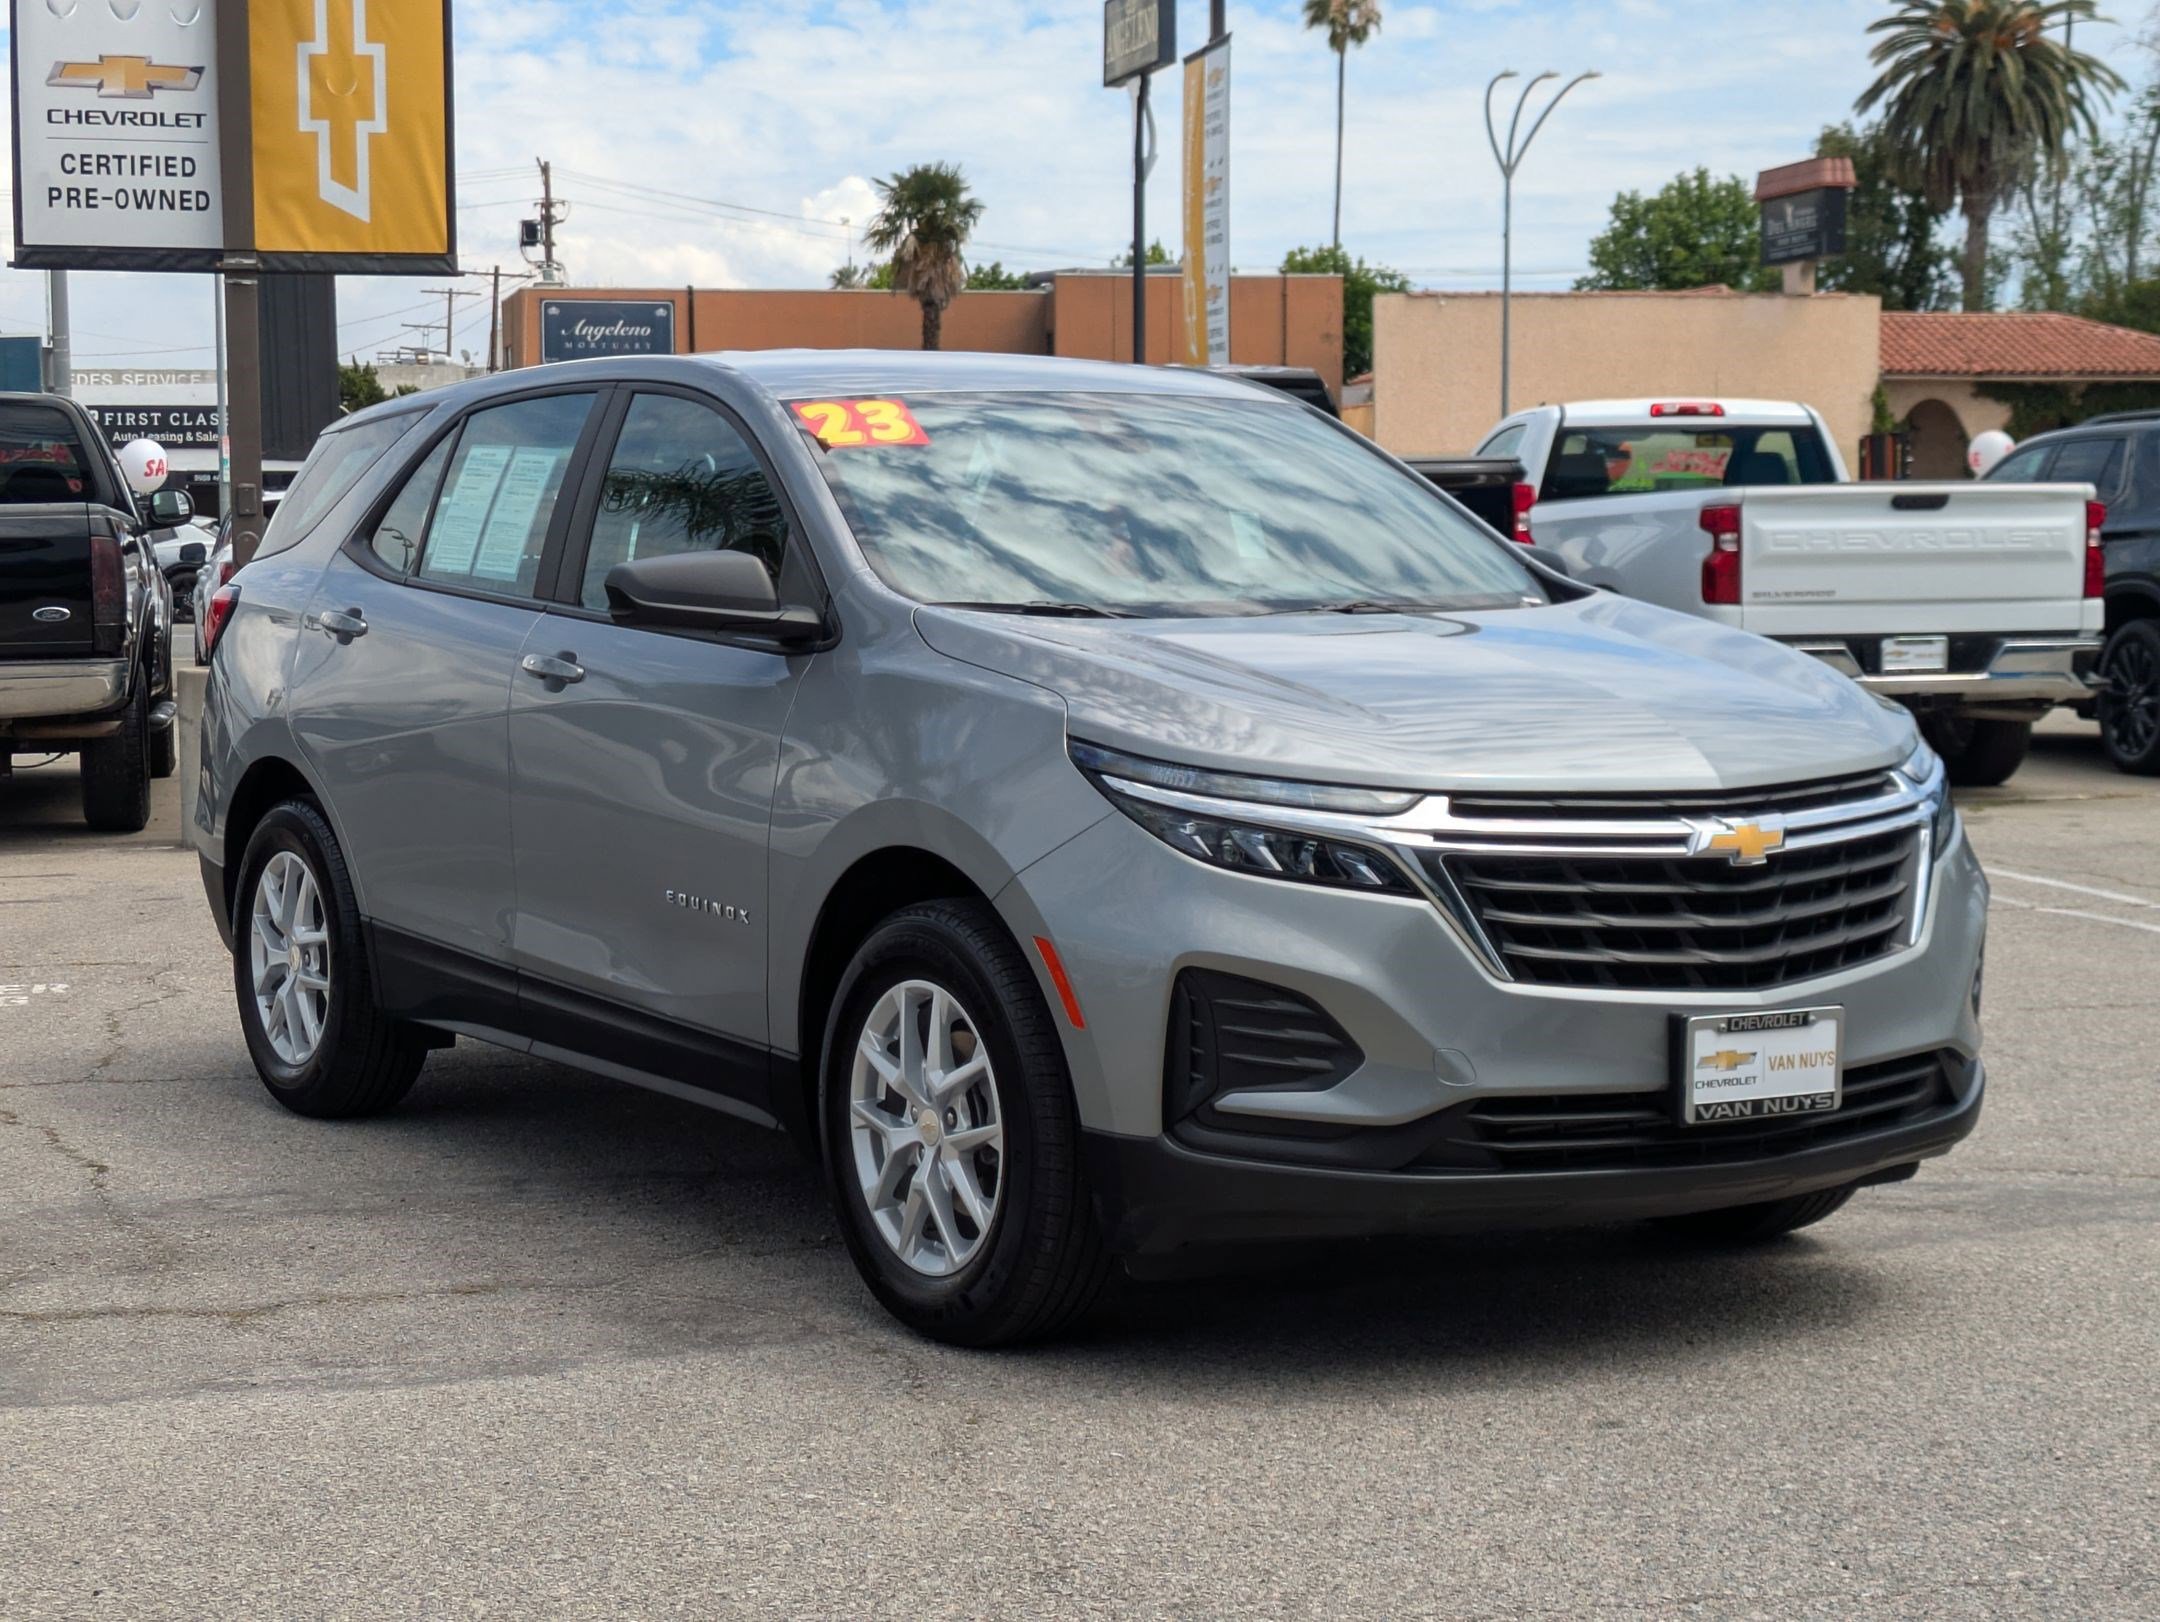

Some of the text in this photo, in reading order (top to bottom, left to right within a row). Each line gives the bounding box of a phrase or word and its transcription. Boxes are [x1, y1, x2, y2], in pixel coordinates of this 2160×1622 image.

[47, 109, 207, 128] CHEVROLET
[60, 152, 197, 178] CERTIFIED
[47, 186, 210, 212] PRE-OWNED
[561, 318, 652, 342] Angeleno
[564, 341, 651, 349] MORTUARY
[121, 373, 201, 385] SERVICE
[104, 412, 228, 426] FIRST CLAS
[800, 400, 917, 446] 23
[185, 431, 194, 442] &
[1770, 529, 2063, 550] CHEVROLET
[666, 889, 750, 925] EQUINOX
[1731, 1013, 1804, 1030] CHEVROLET
[1768, 1051, 1835, 1071] VAN NUYS
[1695, 1076, 1758, 1090] CHEVROLET
[1698, 1093, 1833, 1119] VAN NUYS
